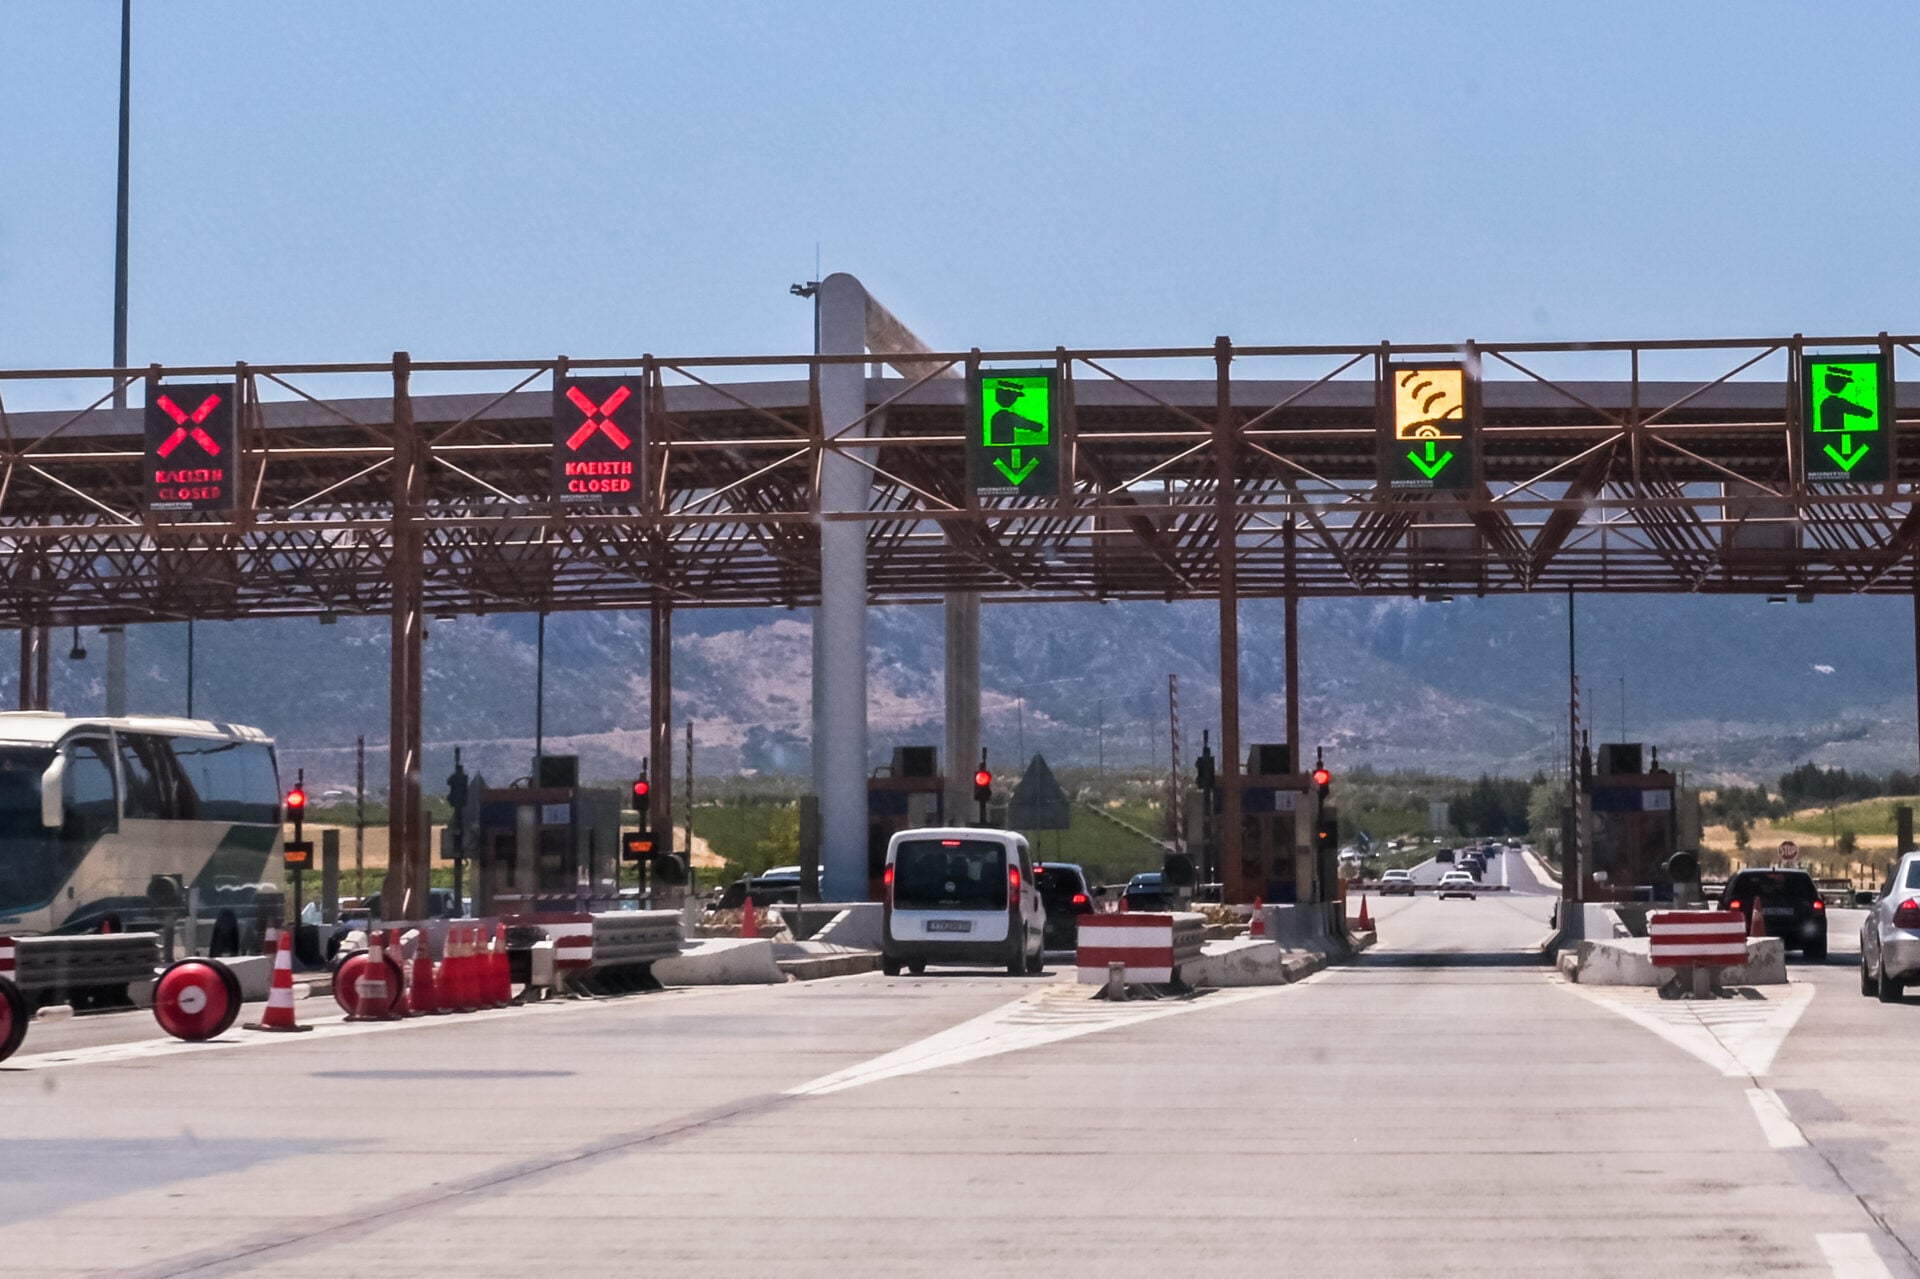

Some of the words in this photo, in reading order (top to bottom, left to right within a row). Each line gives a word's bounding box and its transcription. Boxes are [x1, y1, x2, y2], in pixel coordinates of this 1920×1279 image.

[565, 461, 632, 475] ΚΛΕΙΣΤΗ
[568, 479, 632, 492] CLOSED
[159, 486, 220, 500] CLOSED
[1779, 844, 1797, 857] STOP
